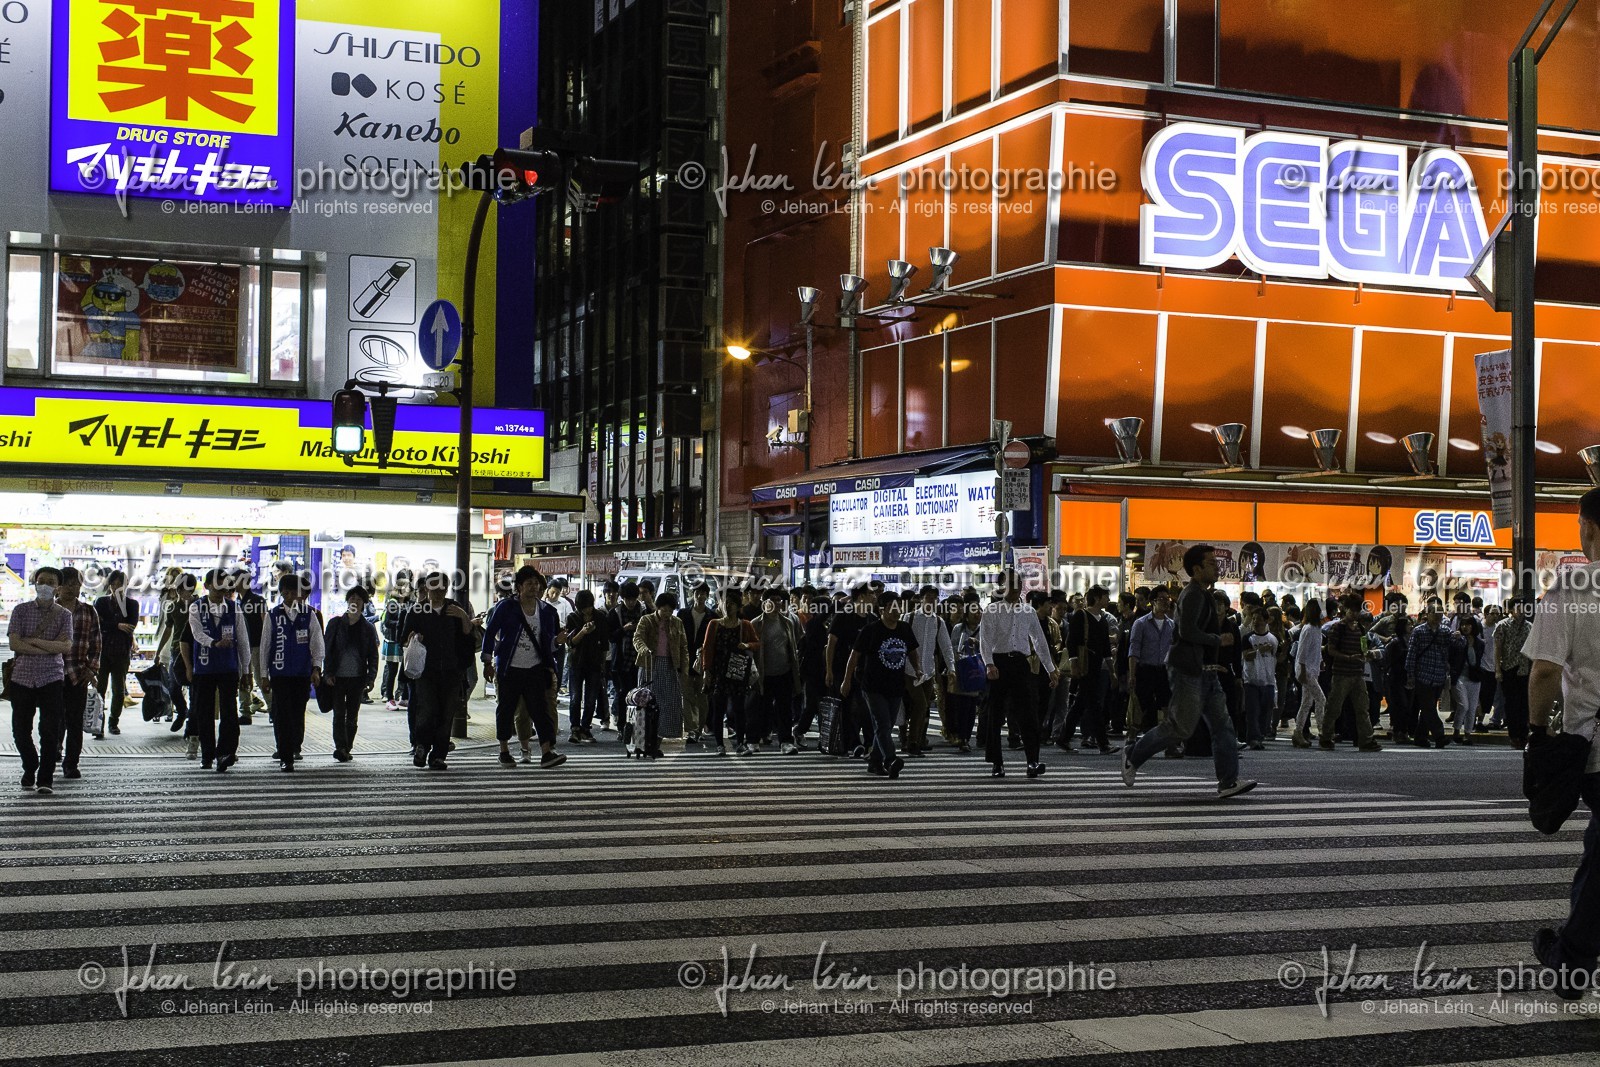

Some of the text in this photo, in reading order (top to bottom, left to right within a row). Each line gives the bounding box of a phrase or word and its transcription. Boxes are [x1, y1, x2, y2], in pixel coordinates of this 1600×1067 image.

[313, 31, 481, 68] SHISEIDO
[97, 0, 256, 121] 薬
[386, 81, 467, 105] KOSÉ
[117, 127, 231, 150] DRUG STORE
[333, 111, 461, 145] Kanebo
[66, 142, 278, 195] マツモトキヨシ
[1142, 123, 1493, 291] SEGA
[188, 286, 229, 307] SOFINA
[190, 278, 232, 300] Kanebo
[69, 413, 267, 459] マツモトキヨシ
[432, 446, 511, 465] Kioshi
[776, 487, 797, 499] CASIO
[813, 482, 837, 495] CASIO
[855, 478, 880, 491] CASIO
[915, 483, 959, 500] ELECTRICAL
[832, 498, 868, 512] CALCULATOR
[873, 488, 908, 503] DIGITAL
[873, 503, 910, 518] CAMERA
[915, 499, 959, 516] DICTIONARY
[1414, 508, 1496, 546] SEGA
[836, 551, 851, 561] DUTY
[852, 551, 866, 560] FREE
[898, 546, 935, 558] デジタルストア
[272, 614, 288, 670] Sofmap
